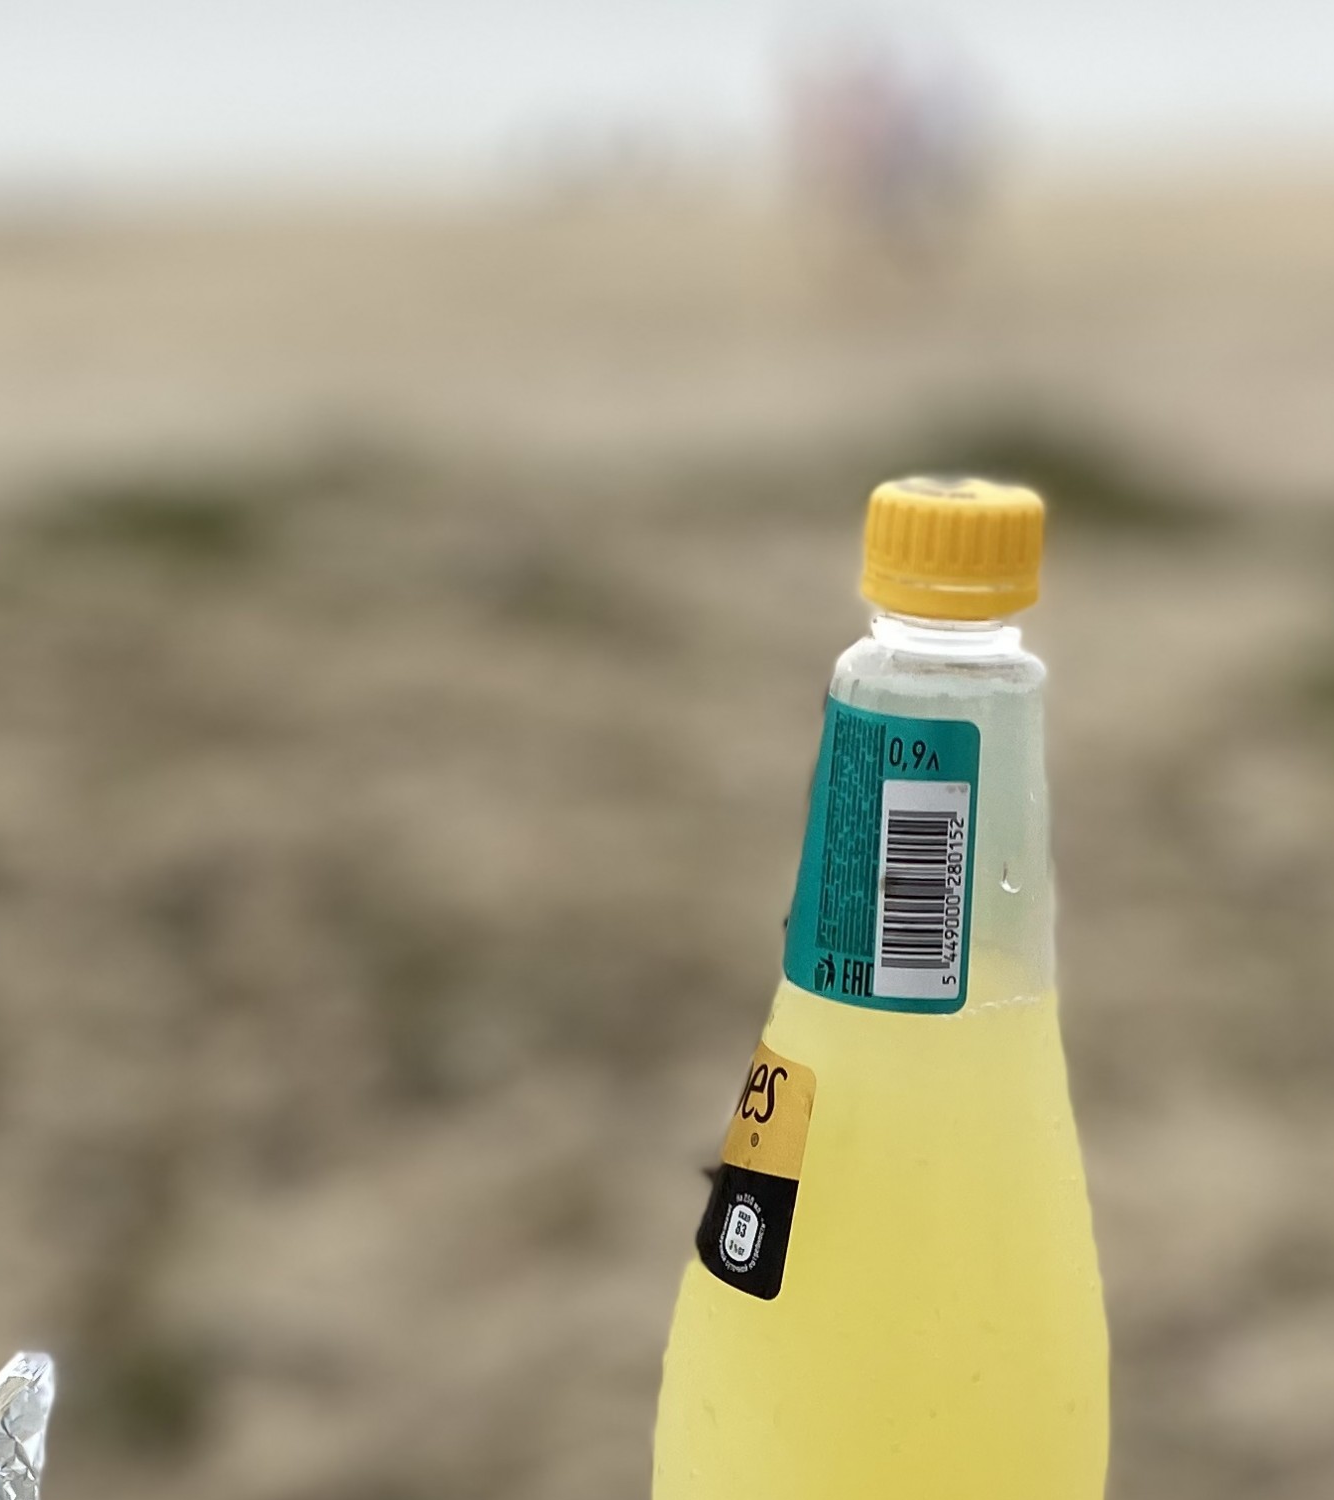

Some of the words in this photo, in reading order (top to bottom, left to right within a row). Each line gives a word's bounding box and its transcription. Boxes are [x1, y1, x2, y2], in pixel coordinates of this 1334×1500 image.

[889, 737, 939, 771] 0,9л
[948, 817, 964, 886] 280152
[945, 895, 961, 963] 449000
[942, 976, 956, 985] 5
[734, 1061, 788, 1123] es
